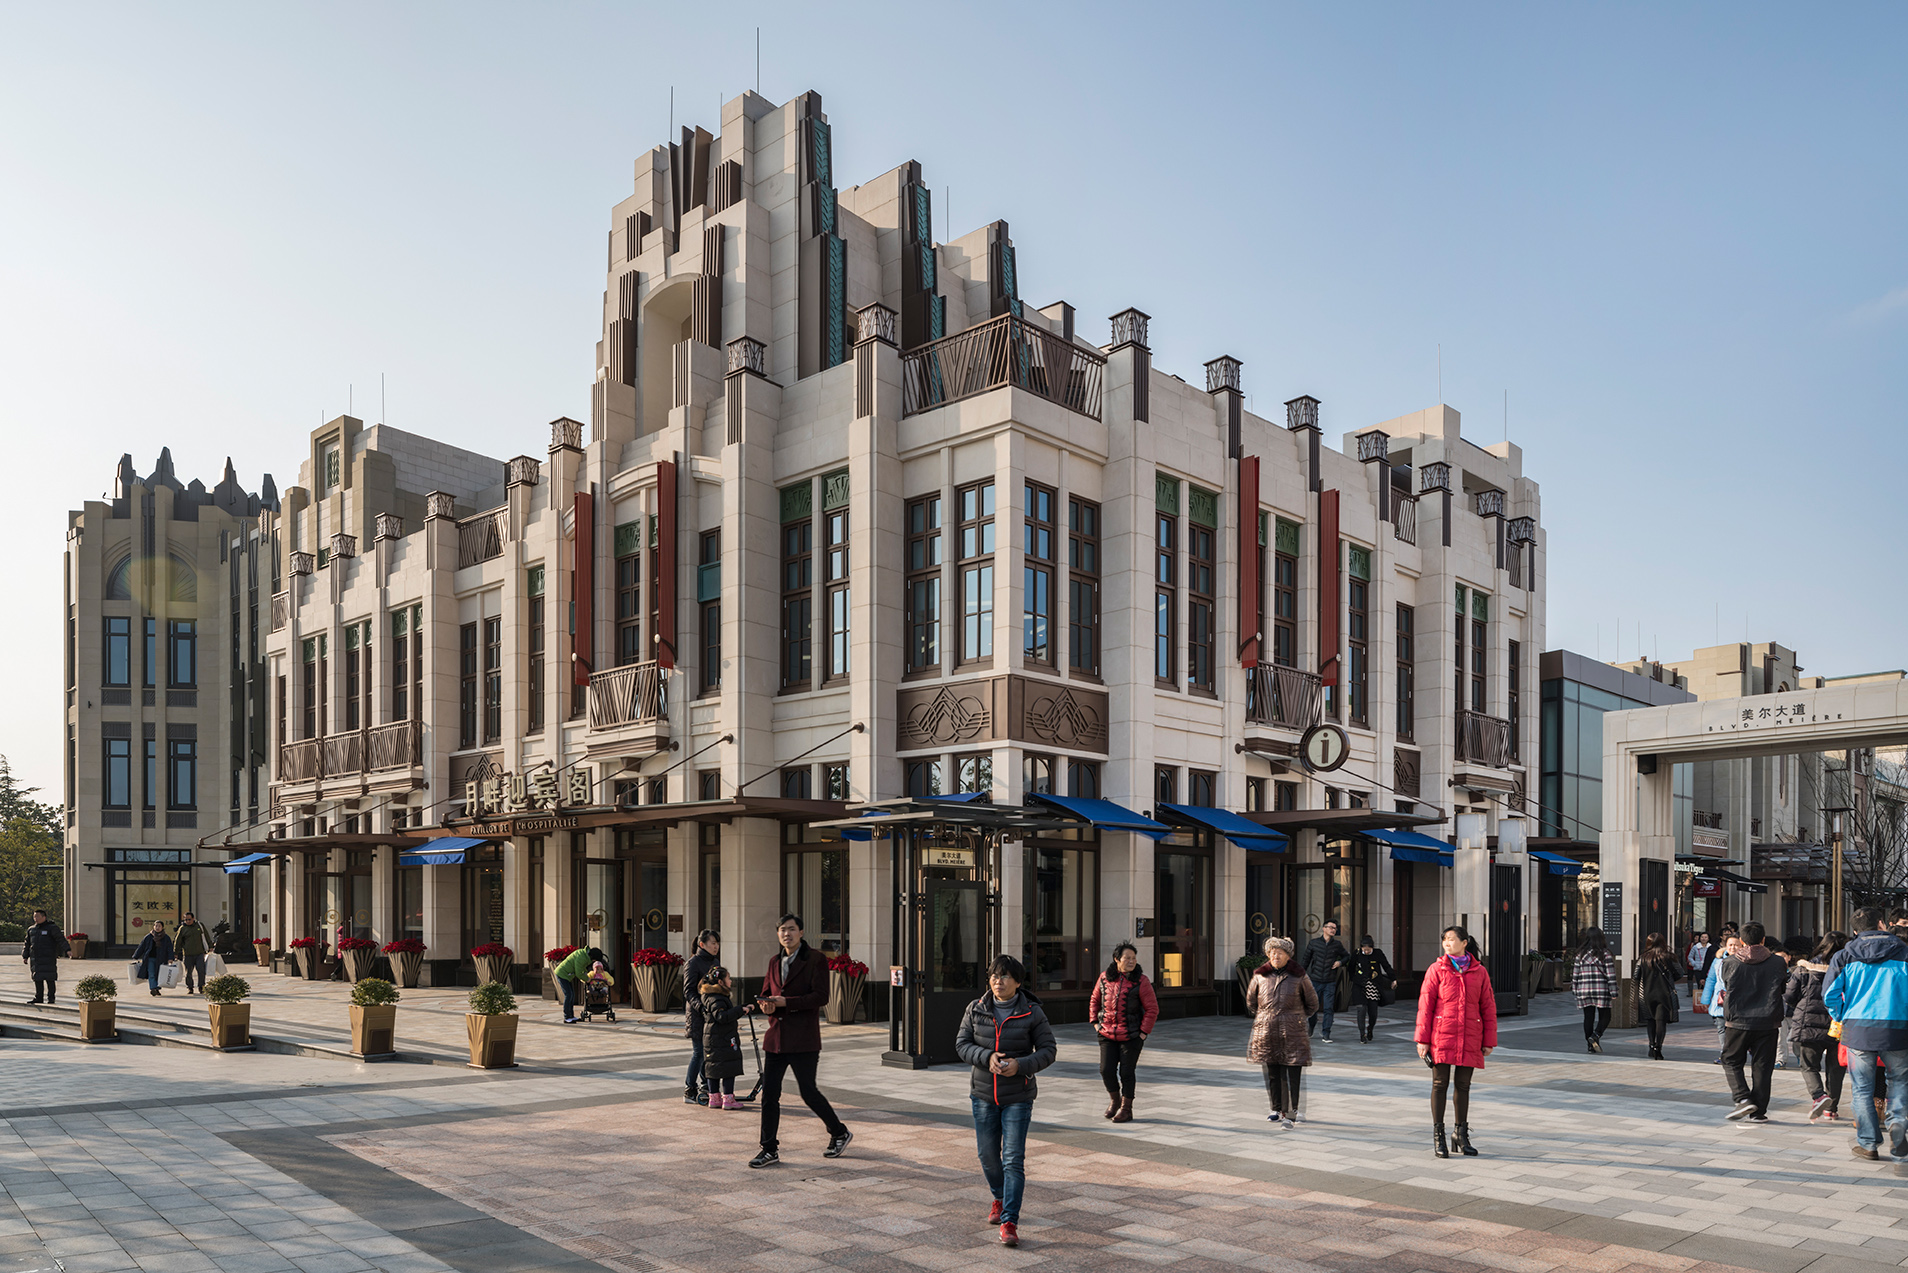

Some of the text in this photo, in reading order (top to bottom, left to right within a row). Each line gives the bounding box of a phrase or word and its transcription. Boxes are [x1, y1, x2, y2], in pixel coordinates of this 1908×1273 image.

[1741, 703, 1806, 721] 美尔大道
[465, 766, 593, 818] 月畔迎宾阁
[500, 823, 509, 833] DE
